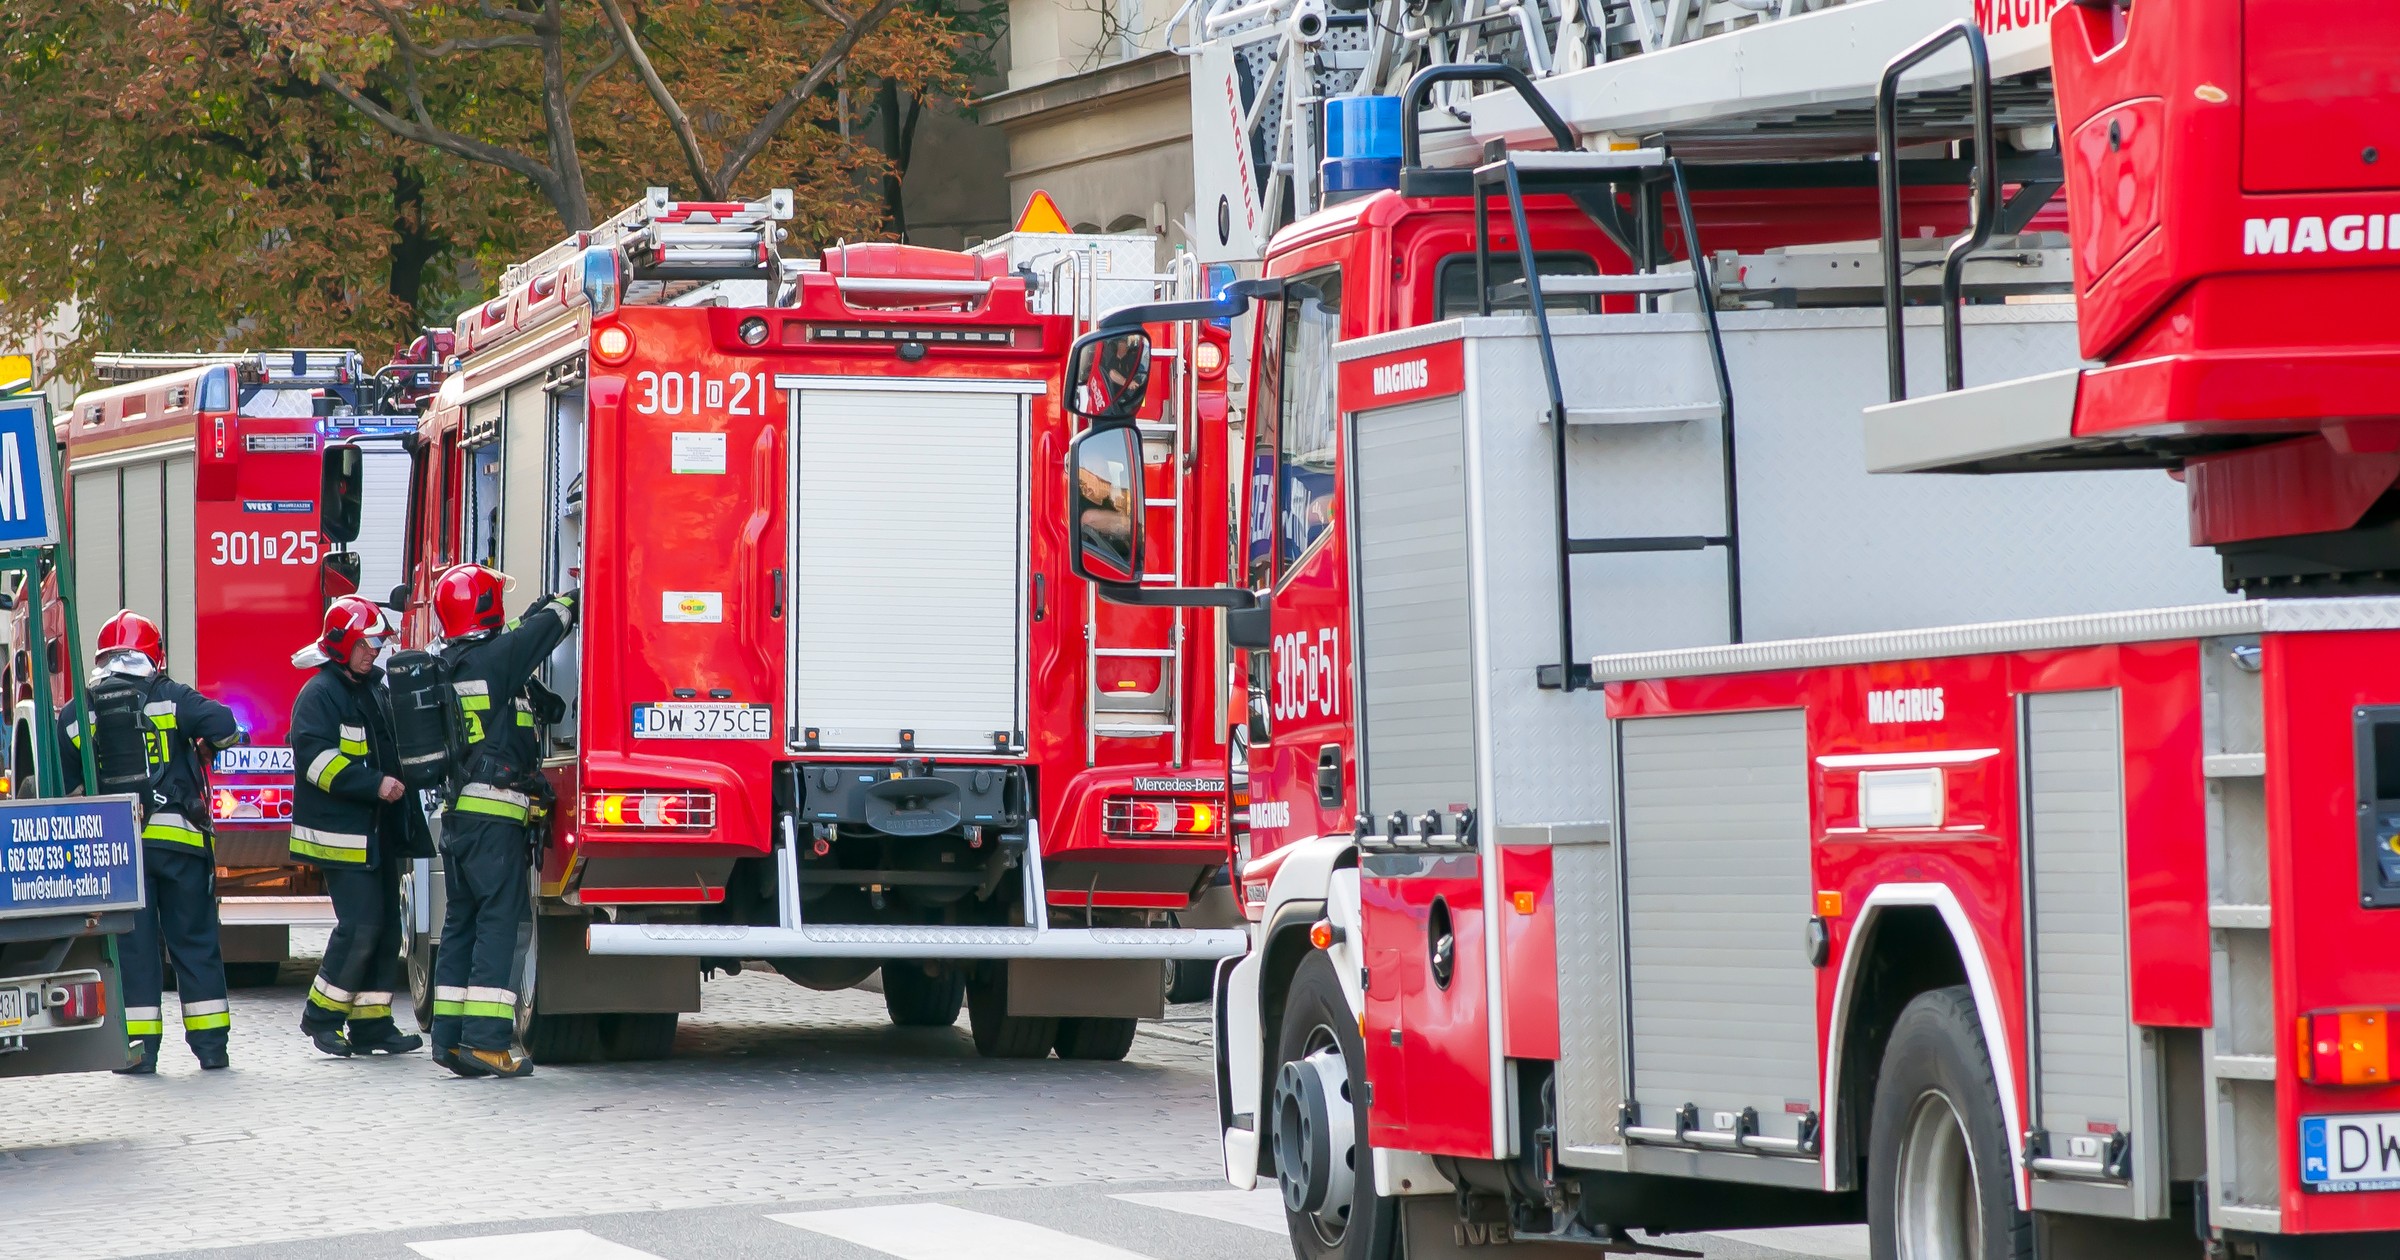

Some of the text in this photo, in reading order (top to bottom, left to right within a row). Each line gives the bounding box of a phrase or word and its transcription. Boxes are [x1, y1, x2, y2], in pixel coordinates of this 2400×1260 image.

[1225, 72, 1254, 231] MAGIRUS
[1373, 358, 1429, 395] MAGIRUS
[1868, 687, 1945, 724] MAGIRUS
[650, 709, 683, 731] DW
[694, 709, 766, 732] 375CE
[224, 750, 251, 768] DW
[1135, 777, 1225, 792] Mercedes-Benz
[11, 814, 103, 843] ZAKŁAD SZKLARSKI
[7, 847, 26, 872] 662
[27, 846, 46, 871] 992
[46, 845, 65, 870] 533
[73, 844, 91, 868] 533
[92, 843, 111, 867] 555
[111, 841, 129, 866] 014
[11, 871, 111, 901] biuro@studio-szkla.pl
[2307, 1157, 2327, 1172] PL
